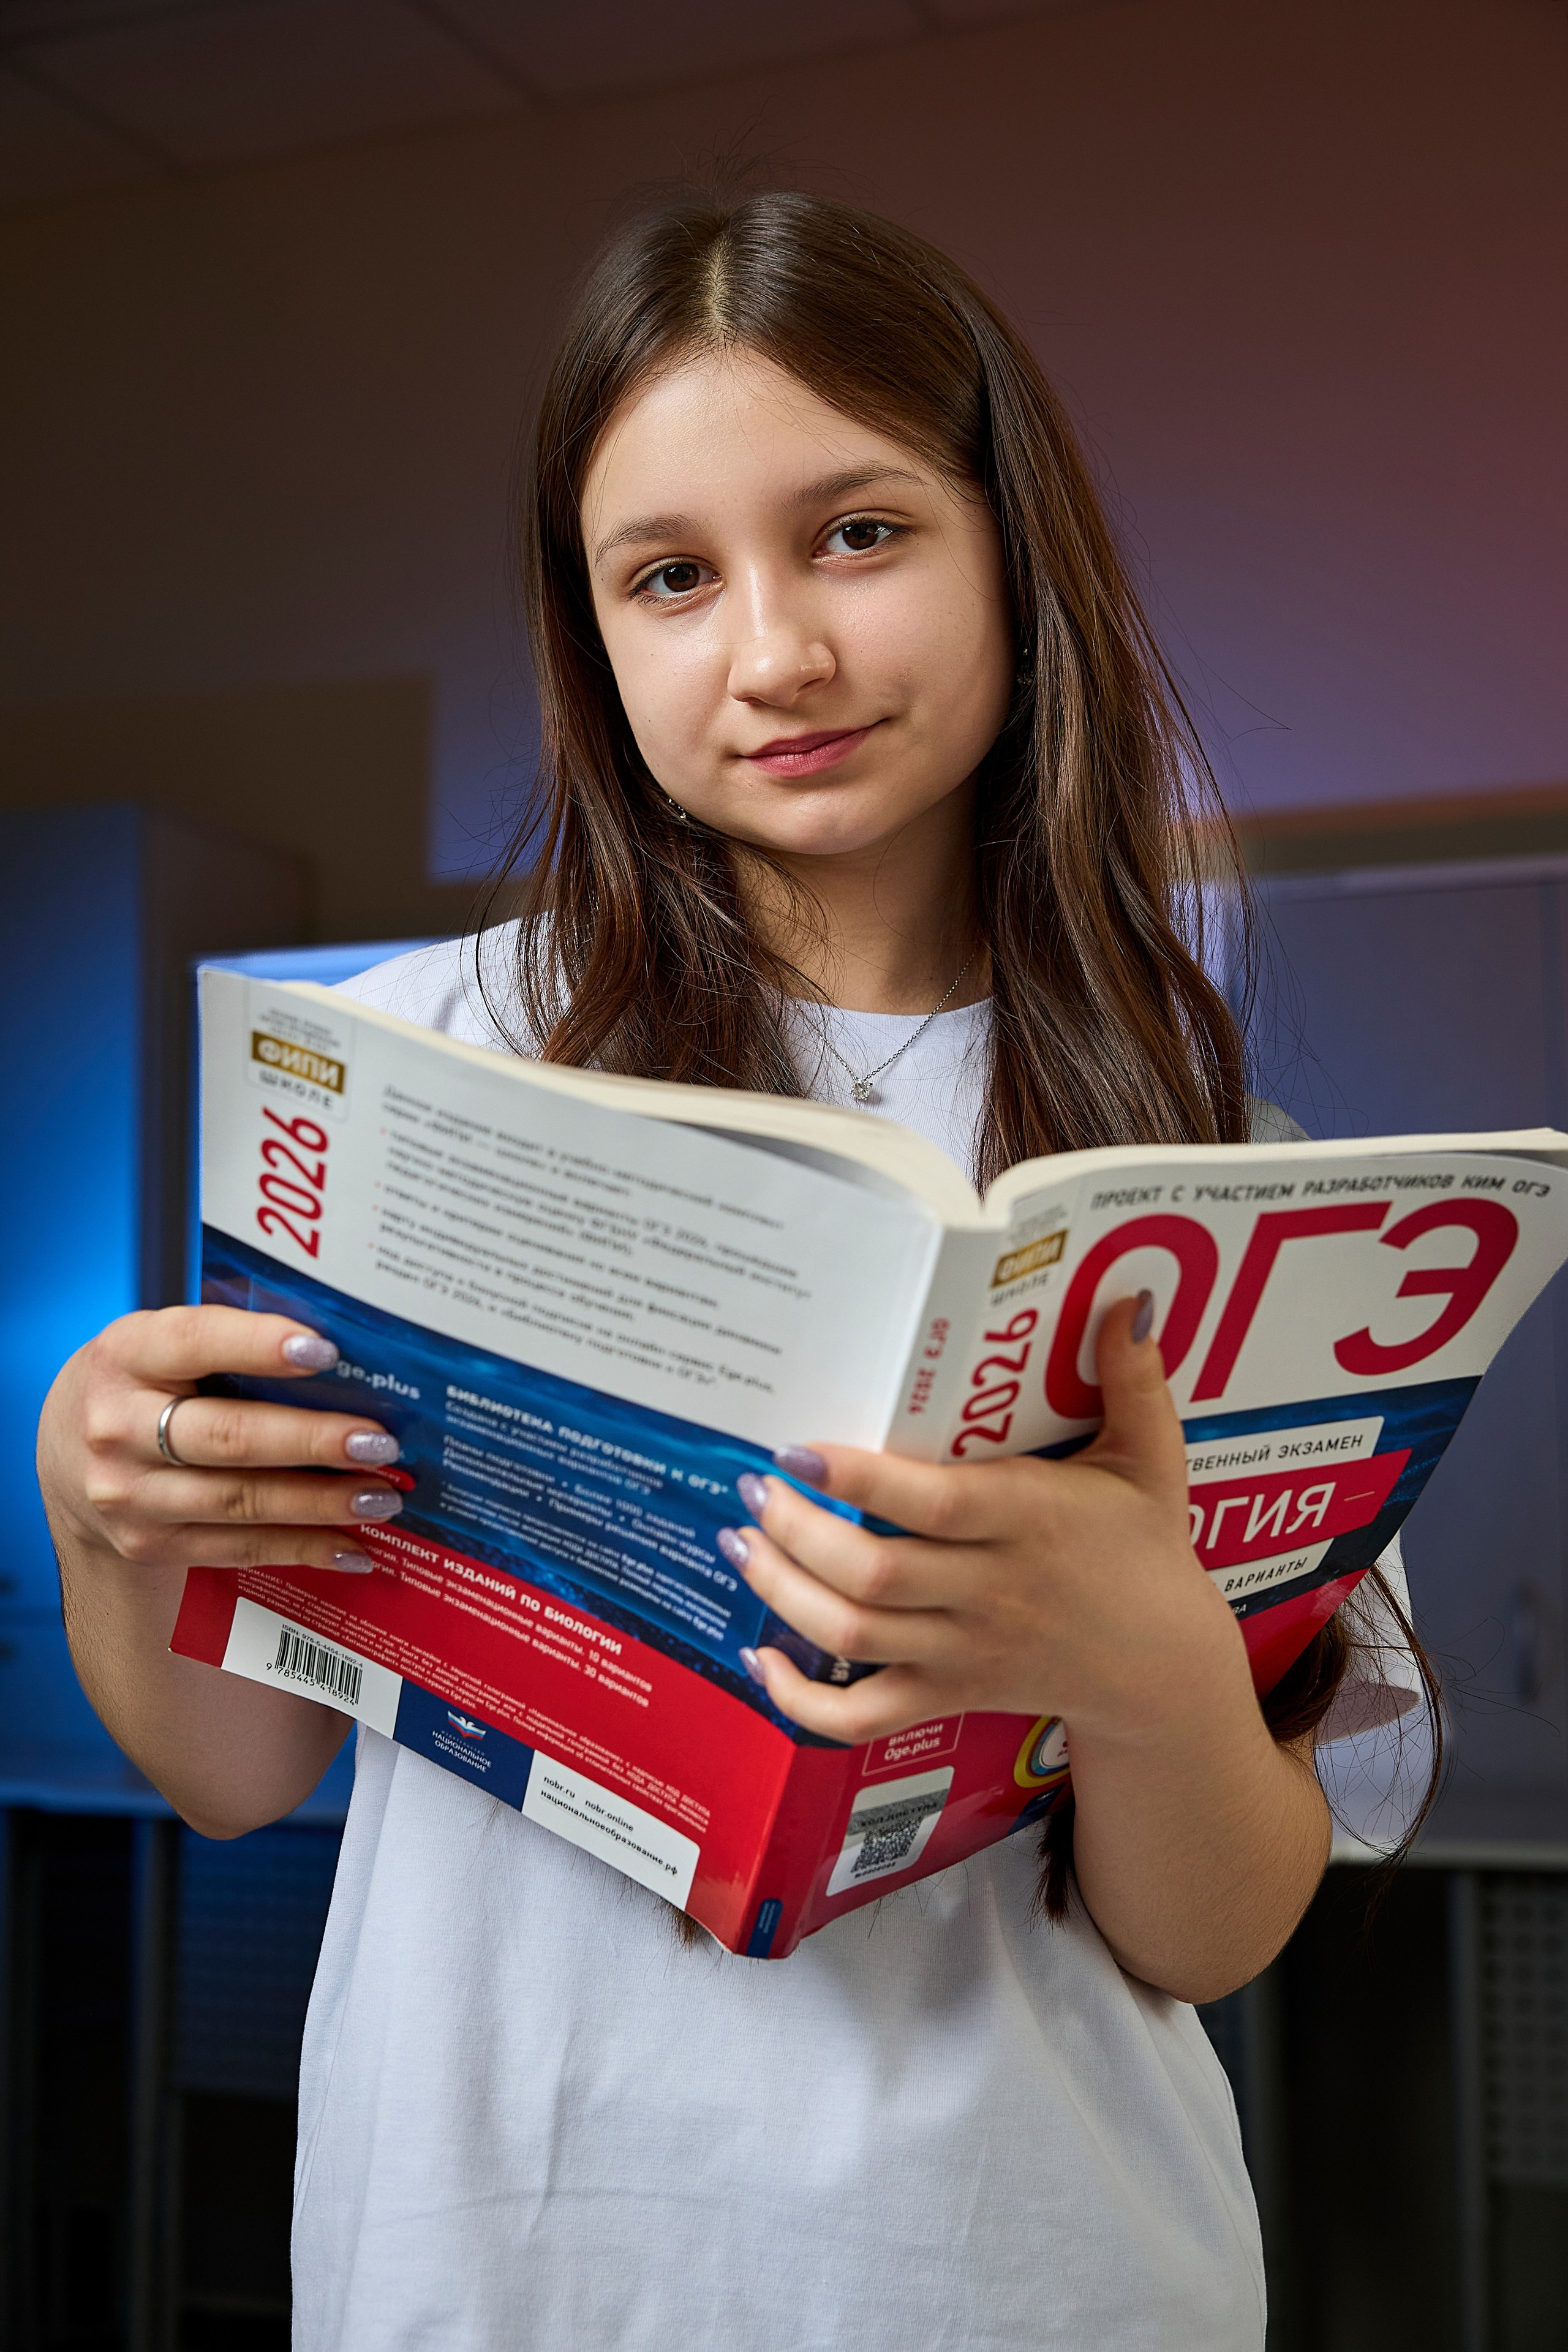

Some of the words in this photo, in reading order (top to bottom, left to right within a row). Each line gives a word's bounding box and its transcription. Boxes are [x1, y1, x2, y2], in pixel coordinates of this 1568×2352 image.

[258, 1039, 339, 1087] ФИПИ
[257, 1107, 328, 1258] 2026
[1090, 1185, 1164, 1210] ПРОЕКТ
[1170, 1184, 1185, 1202] С
[1193, 1182, 1297, 1202] УЧАСТИЕМ
[1302, 1173, 1455, 1197] РАЗРАБОТЧИКОВ
[1461, 1174, 1506, 1192] КИМ
[1512, 1179, 1551, 1198] ОГЭ
[1044, 1197, 1519, 1420] ОГЭ
[337, 1359, 421, 1400] ge.plus
[951, 1309, 1039, 1457] 2026
[447, 1384, 552, 1433] БИБЛИОТЕКА
[558, 1425, 666, 1475] ПОДГОТОВКИ
[671, 1468, 684, 1482] К
[1278, 1434, 1363, 1459] ЭКЗАМЕН
[360, 1524, 439, 1563] КОМПЛЕКТ
[443, 1558, 516, 1600] ИЗДАНИЙ
[521, 1594, 541, 1612] ПО
[544, 1605, 622, 1656] БИОЛОГИИ
[1224, 1556, 1308, 1593] ВАРИАНТЫ
[282, 1624, 300, 1637] ISBN:
[364, 1544, 398, 1563] логия.
[401, 1558, 443, 1583] Типовые
[445, 1579, 534, 1629] экзаменационные
[589, 1649, 600, 1663] 10
[601, 1658, 652, 1693] вариантов
[400, 1571, 442, 1598] Типовые
[443, 1593, 530, 1644] экзаменационные
[583, 1664, 597, 1678] 30
[598, 1673, 649, 1708] вариантов
[277, 1667, 315, 1686] 785445
[320, 1684, 355, 1705] 418924
[432, 1730, 492, 1768] НАЦИОНАЛЬНОЕ
[434, 1740, 487, 1773] ОБРАЗОВАНИЕ
[884, 1737, 941, 1762] Oge.plus
[889, 1723, 944, 1746] ВКЛЮЧИ
[543, 1776, 575, 1799] nobr.ru
[584, 1800, 634, 1832] nobr.online
[541, 1789, 678, 1875] национальноеобразование.рф
